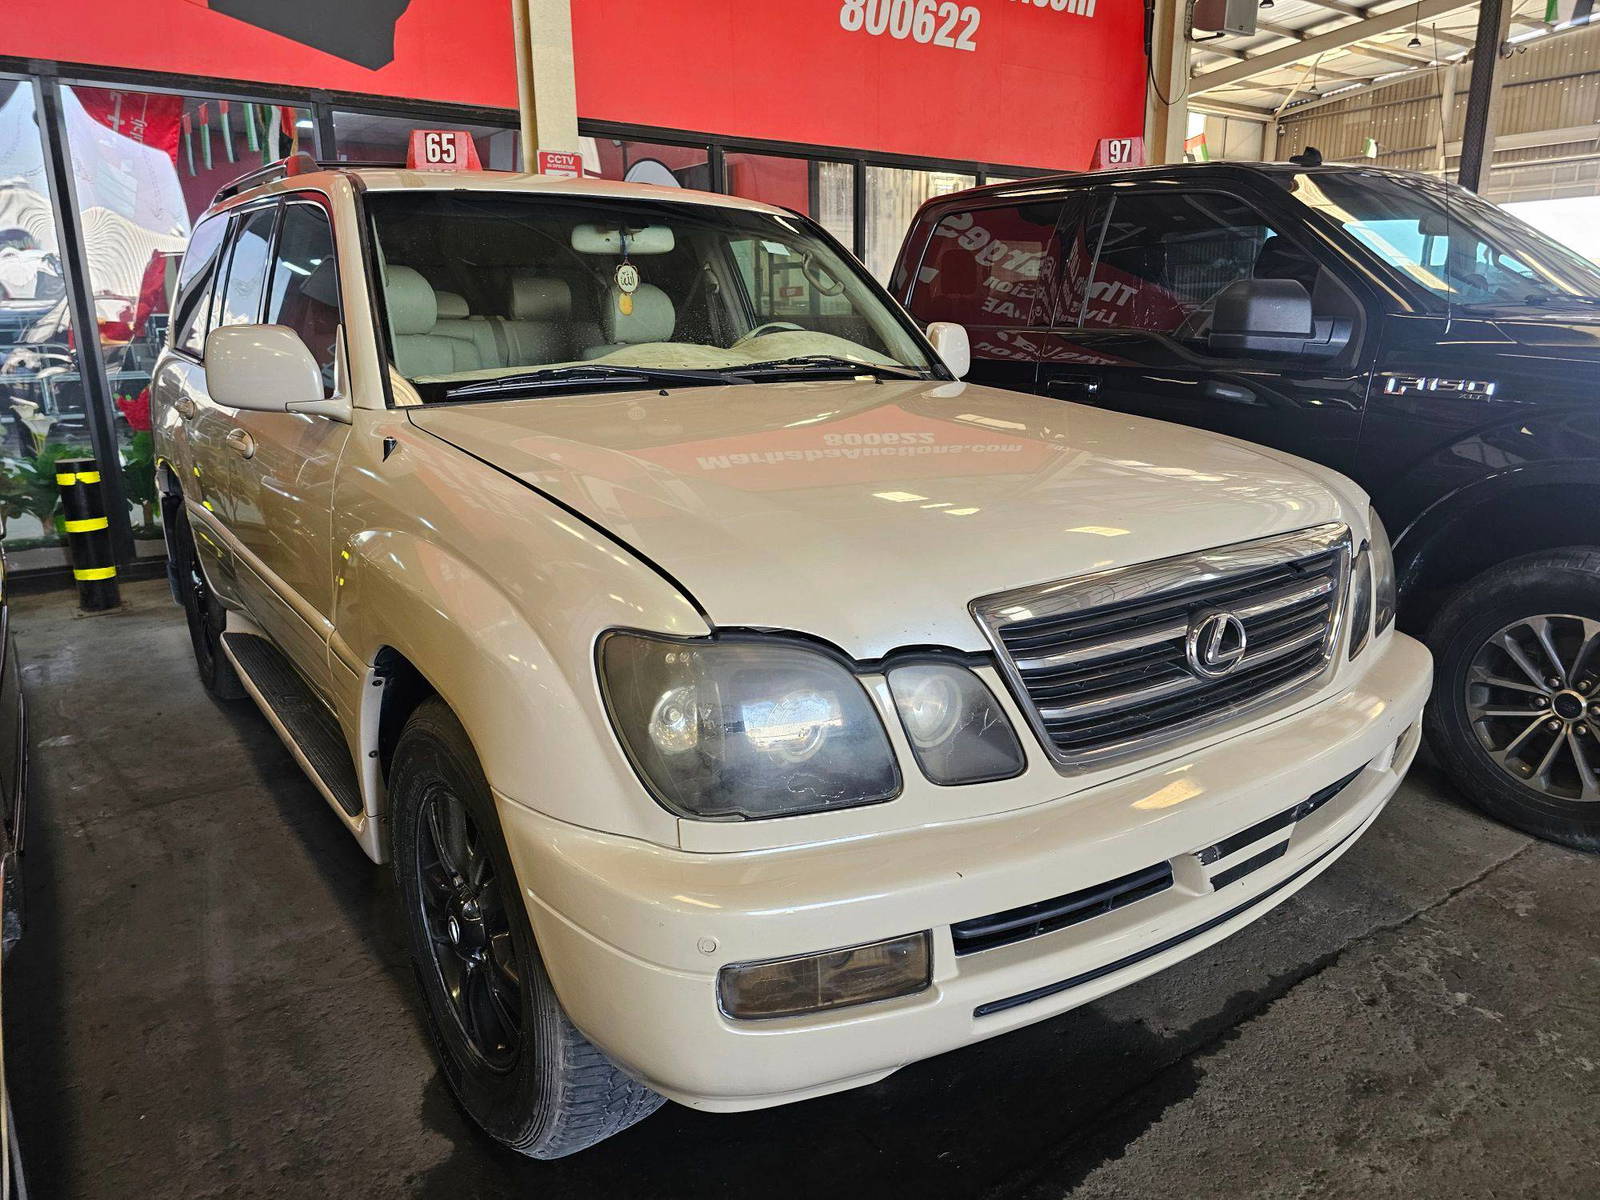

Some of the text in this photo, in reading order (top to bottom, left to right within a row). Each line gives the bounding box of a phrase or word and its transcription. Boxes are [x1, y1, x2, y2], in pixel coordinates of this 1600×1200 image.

[839, 0, 981, 51] 800622
[426, 133, 456, 163] 65
[547, 154, 574, 165] CCTV
[1110, 139, 1131, 163] 97
